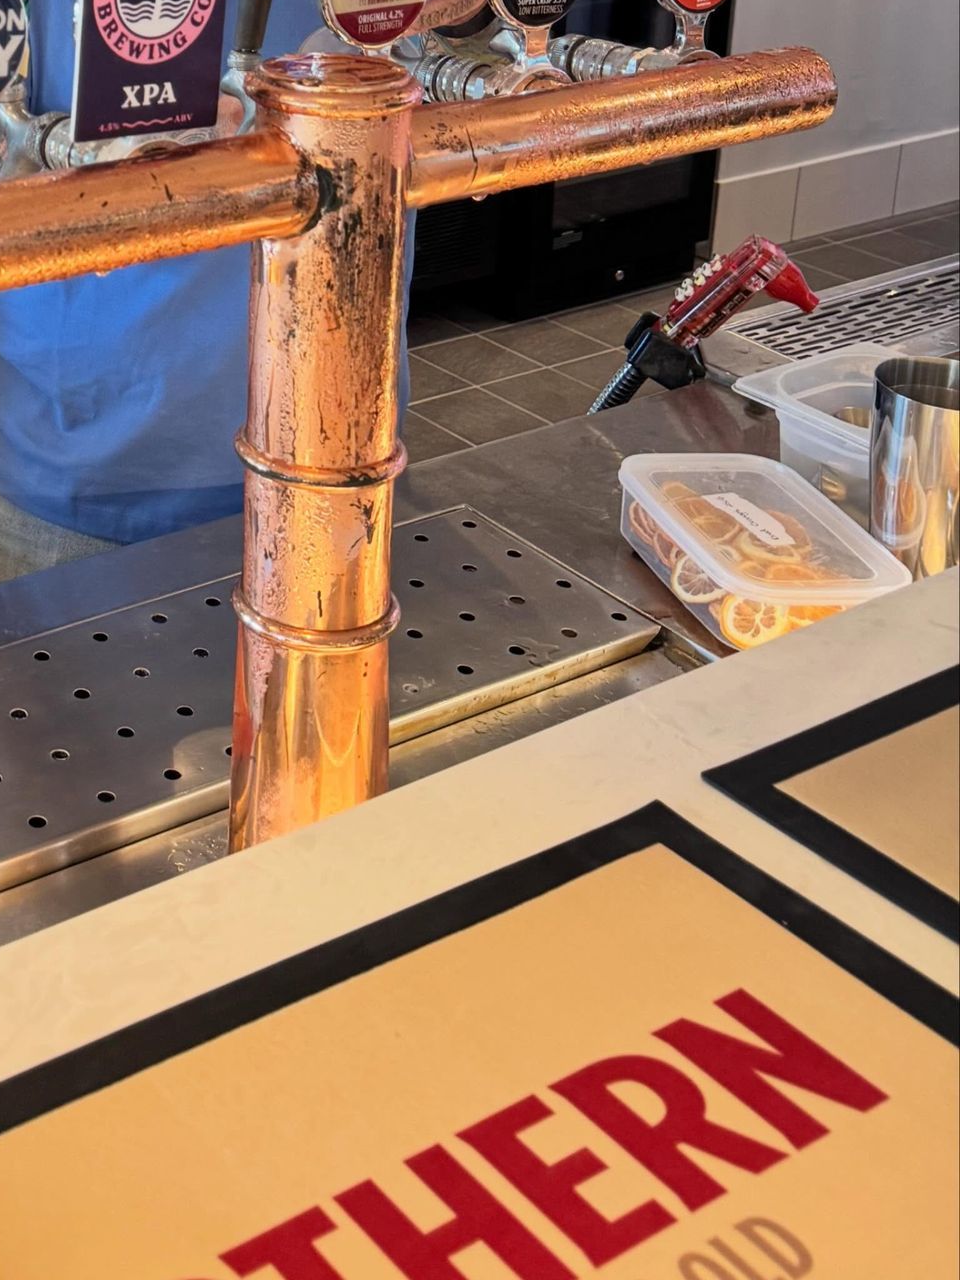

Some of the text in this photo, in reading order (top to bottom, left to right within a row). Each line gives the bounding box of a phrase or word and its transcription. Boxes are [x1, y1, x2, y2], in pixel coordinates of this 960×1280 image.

[357, 10, 388, 25] ORIGINAL
[518, 4, 564, 16] LOW BITTERNESS
[96, 2, 189, 61] BREWING
[358, 19, 404, 35] FULL STRENGTH
[120, 81, 178, 109] XPA
[153, 986, 892, 1280] THERN
